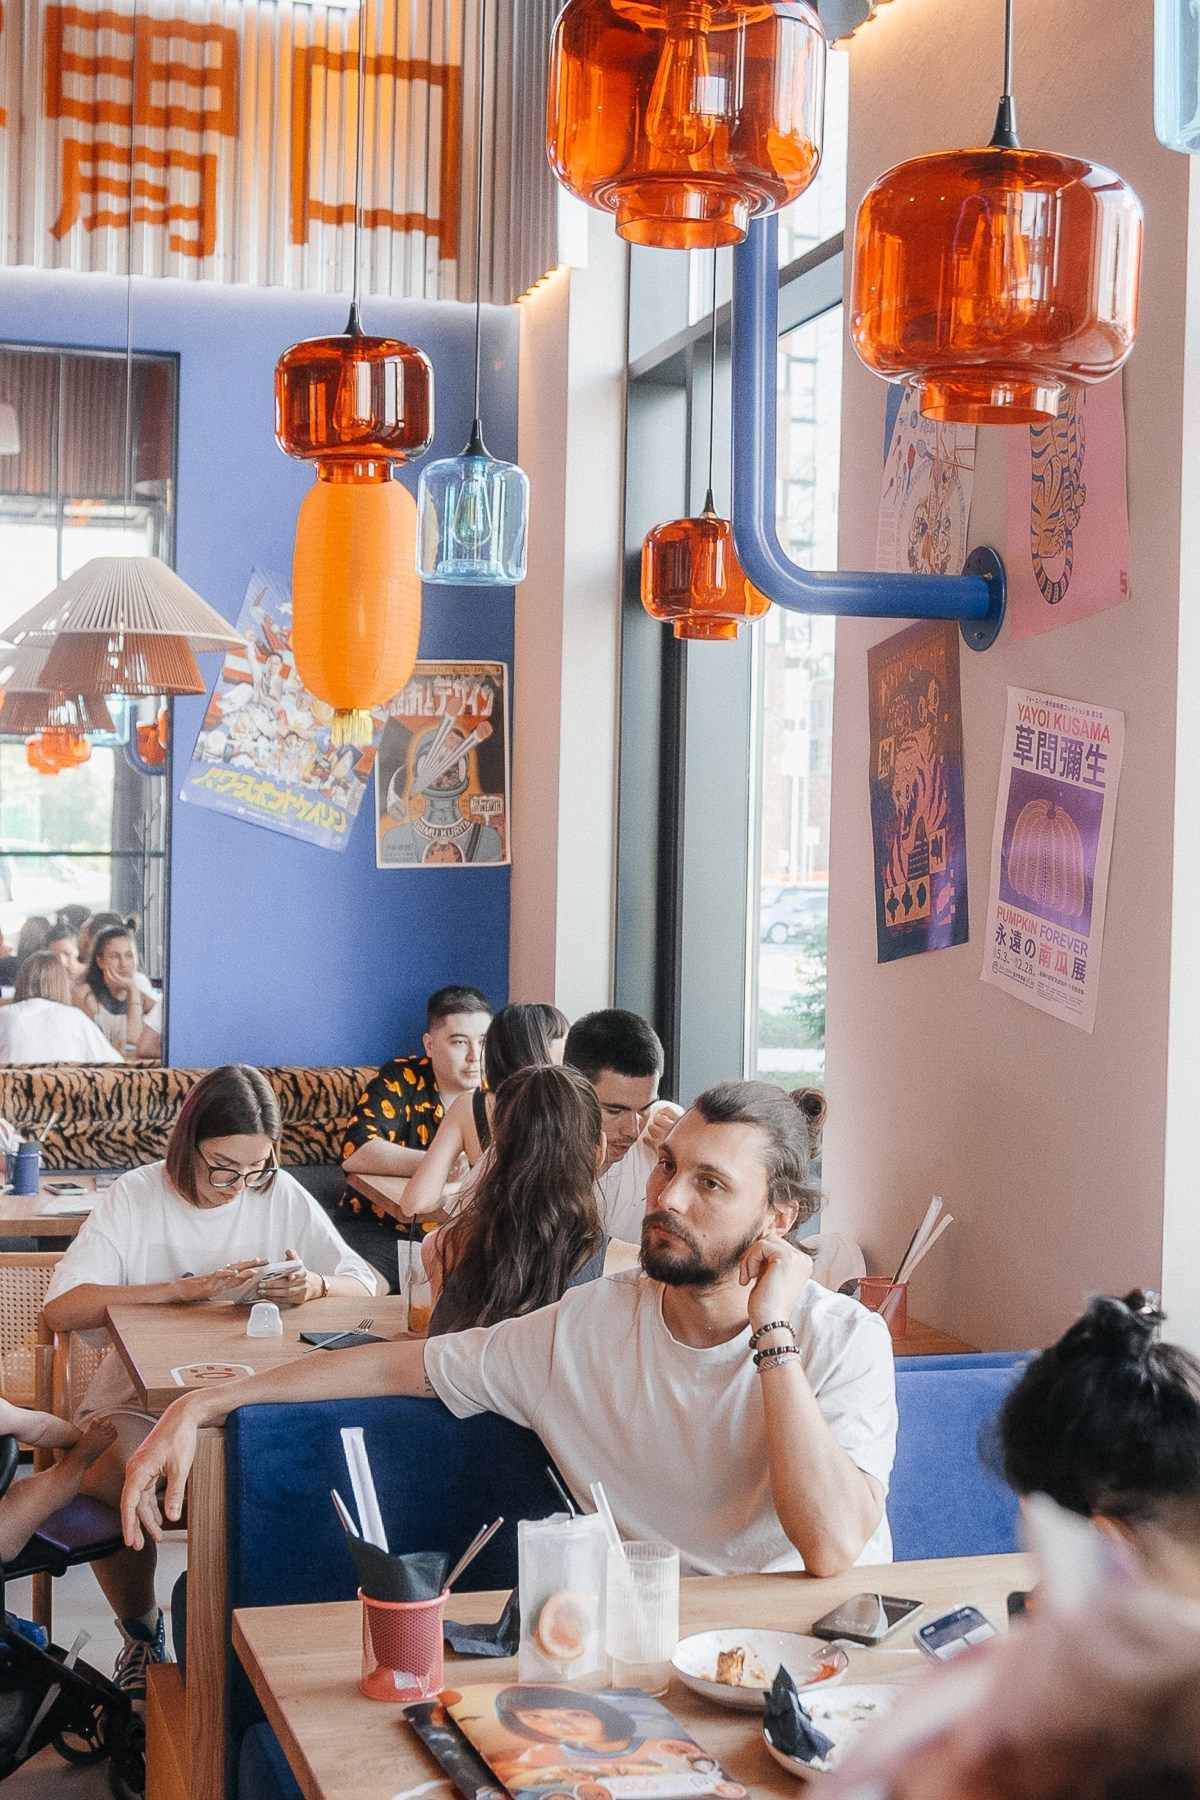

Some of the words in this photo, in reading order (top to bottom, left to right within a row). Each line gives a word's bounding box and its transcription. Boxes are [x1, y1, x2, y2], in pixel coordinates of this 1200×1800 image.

[0, 4, 461, 260] 胃口
[1018, 703, 1050, 728] YAYOI
[1053, 712, 1110, 743] KUSAMA
[1013, 724, 1107, 788] 草間彌生
[440, 820, 470, 837] KURITA
[996, 906, 1038, 935] PUMPKIN
[1040, 925, 1088, 957] FOREVER
